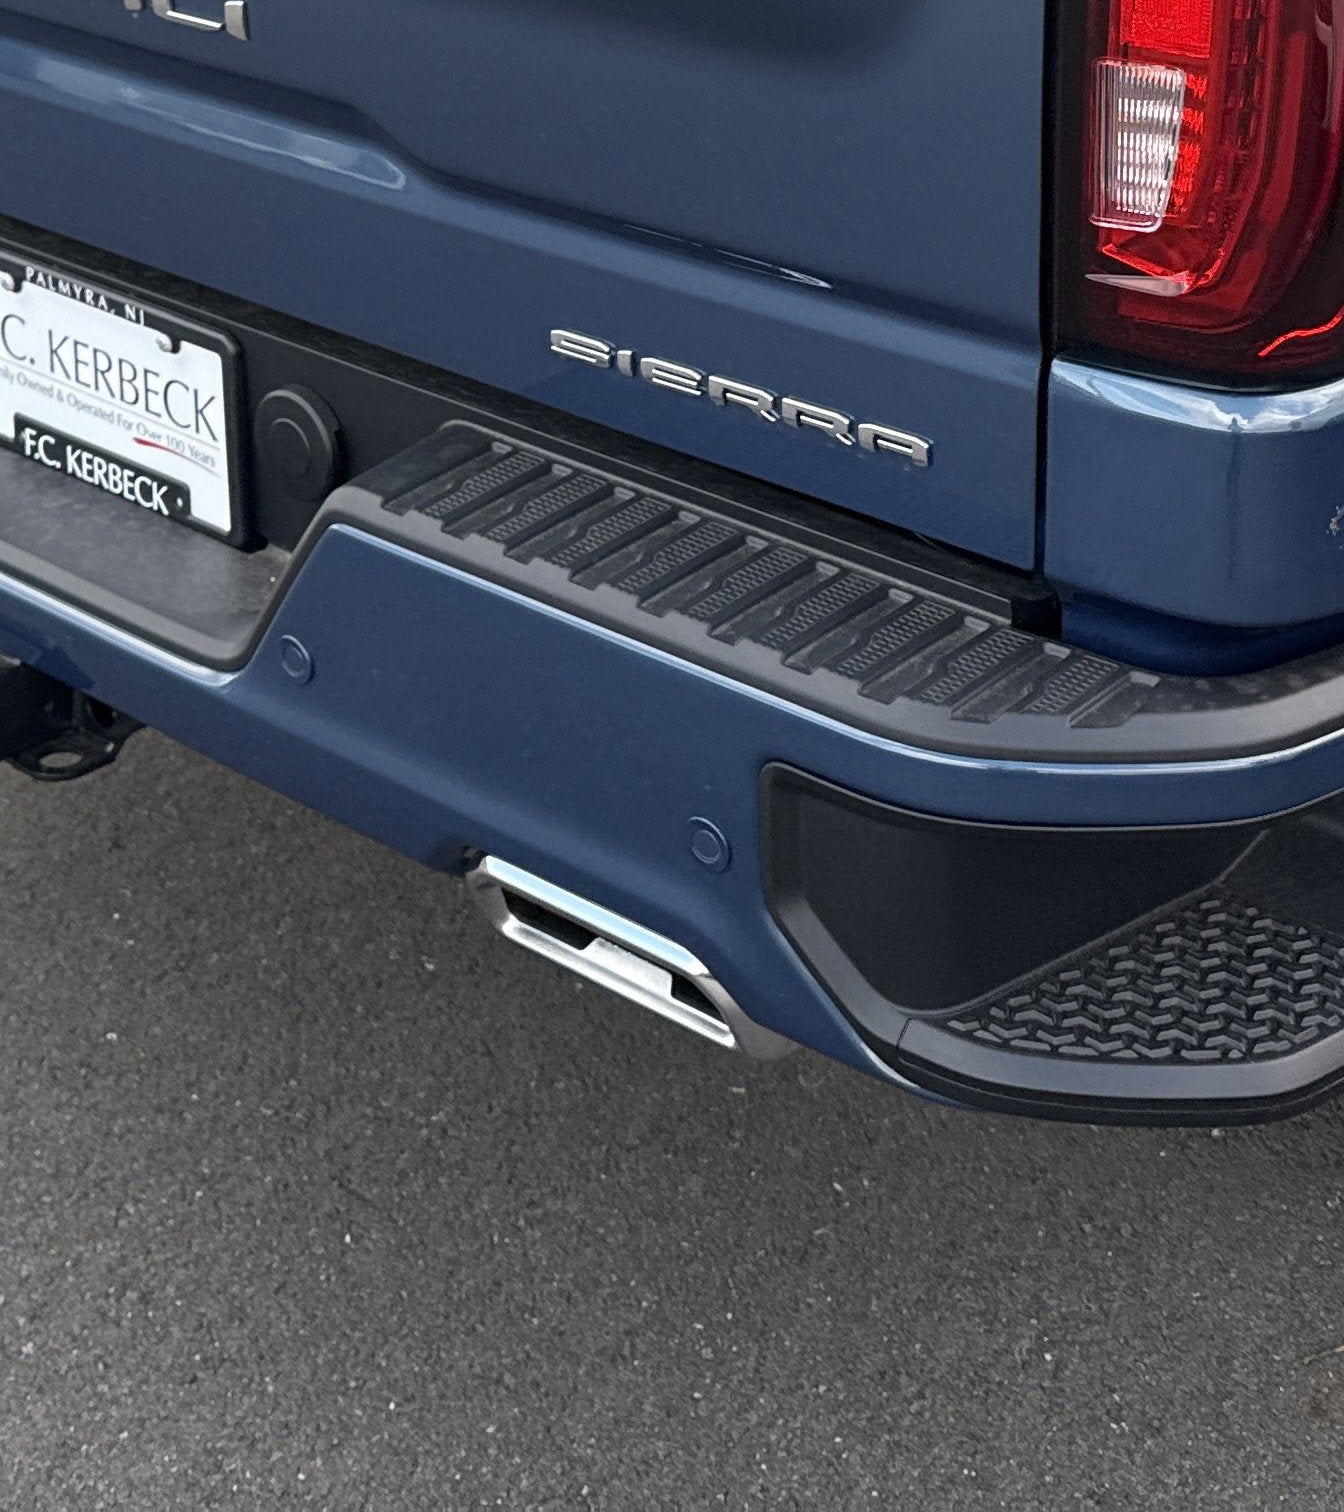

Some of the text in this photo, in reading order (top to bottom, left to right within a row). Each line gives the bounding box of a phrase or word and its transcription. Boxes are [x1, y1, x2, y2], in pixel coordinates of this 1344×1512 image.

[24, 265, 117, 315] PALMYRA,
[16, 371, 54, 398] Owned
[66, 392, 115, 426] Operated
[116, 412, 134, 430] For
[136, 421, 163, 441] Over
[165, 434, 186, 453] 100
[187, 443, 217, 468] Years
[47, 329, 218, 442] KERBECK
[549, 328, 936, 468] SIERRA
[22, 426, 170, 516] F.C. KERBECK
